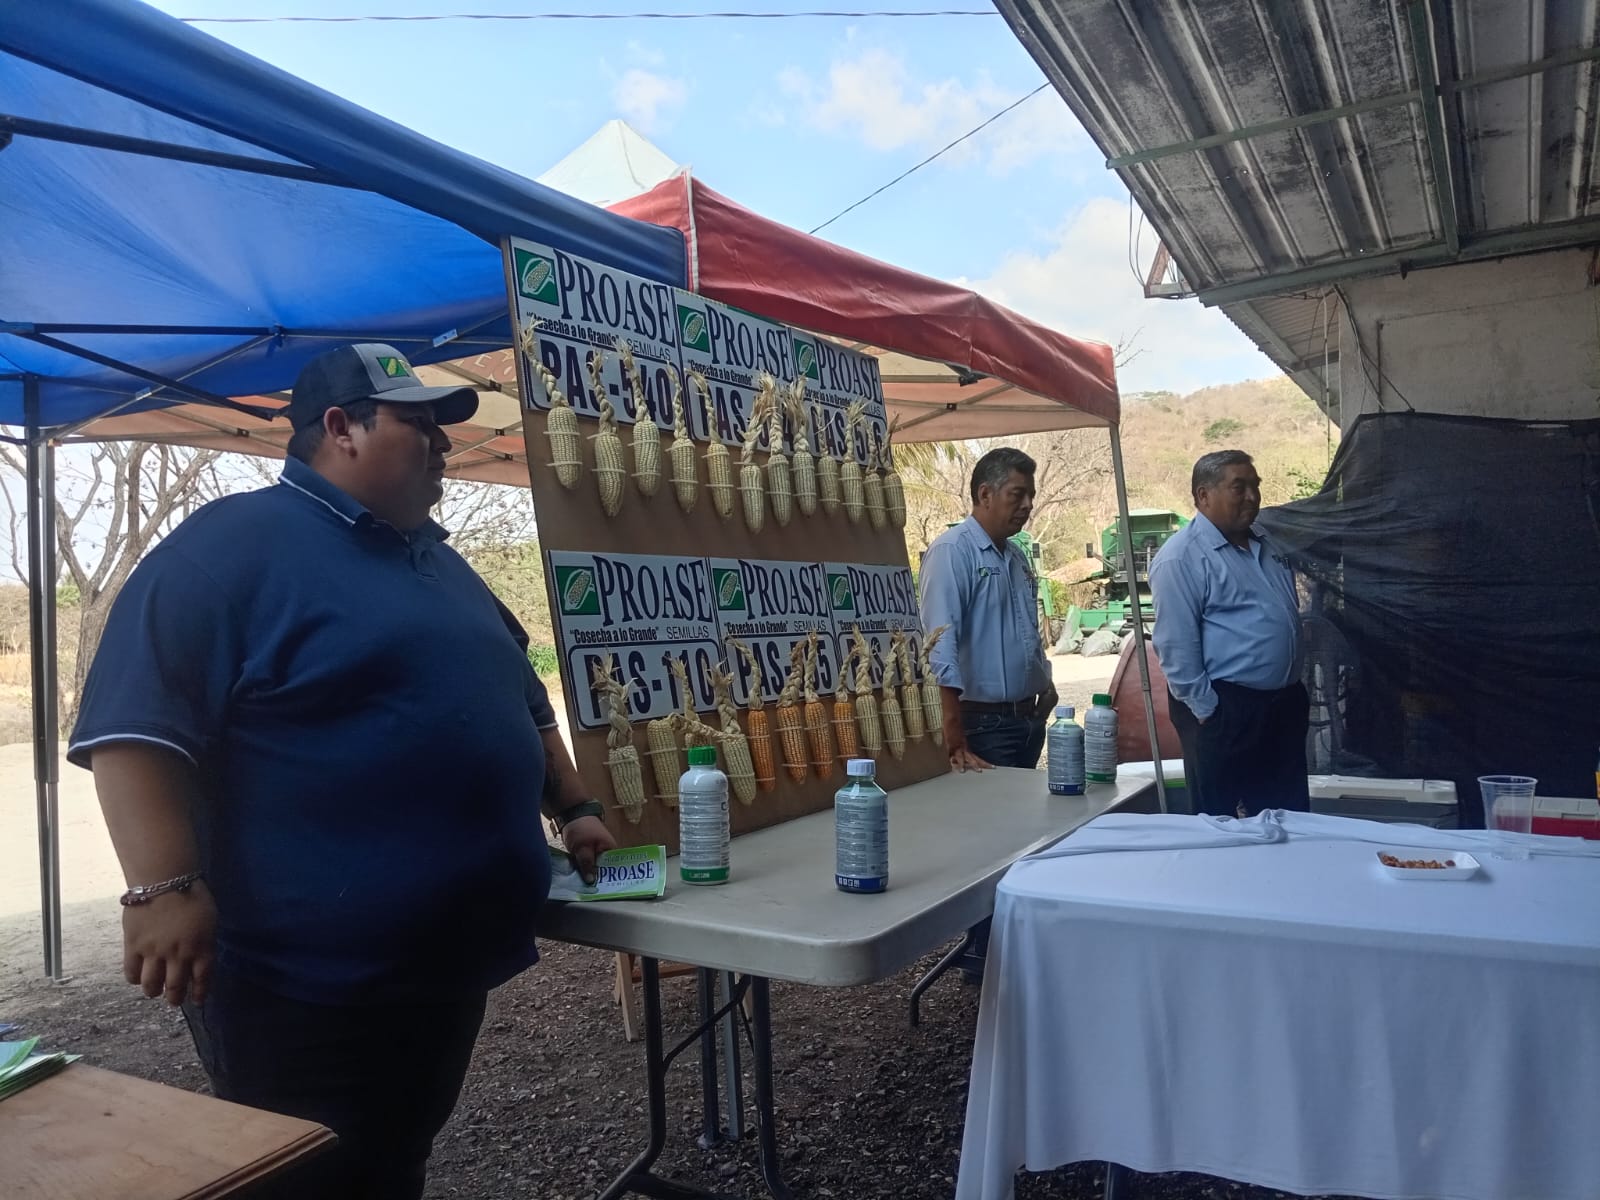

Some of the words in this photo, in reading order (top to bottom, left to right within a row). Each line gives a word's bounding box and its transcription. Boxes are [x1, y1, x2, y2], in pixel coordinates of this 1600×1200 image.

[553, 248, 676, 348] PROASE
[571, 325, 577, 337] a
[580, 326, 586, 340] lo
[587, 327, 619, 347] Grande"
[627, 338, 670, 360] SEMILLAS
[705, 303, 794, 383] PROASE
[813, 336, 883, 405] PROASE
[592, 555, 713, 627] PROASE
[738, 560, 829, 620] PROASE
[847, 565, 918, 618] PROASE
[570, 628, 612, 643] "Cosecha
[612, 629, 620, 642] a
[620, 628, 628, 642] lo
[629, 626, 659, 641] Grande"
[666, 625, 709, 639] SEMILLAS
[584, 648, 716, 720] PAS-110
[598, 861, 655, 883] PROASE
